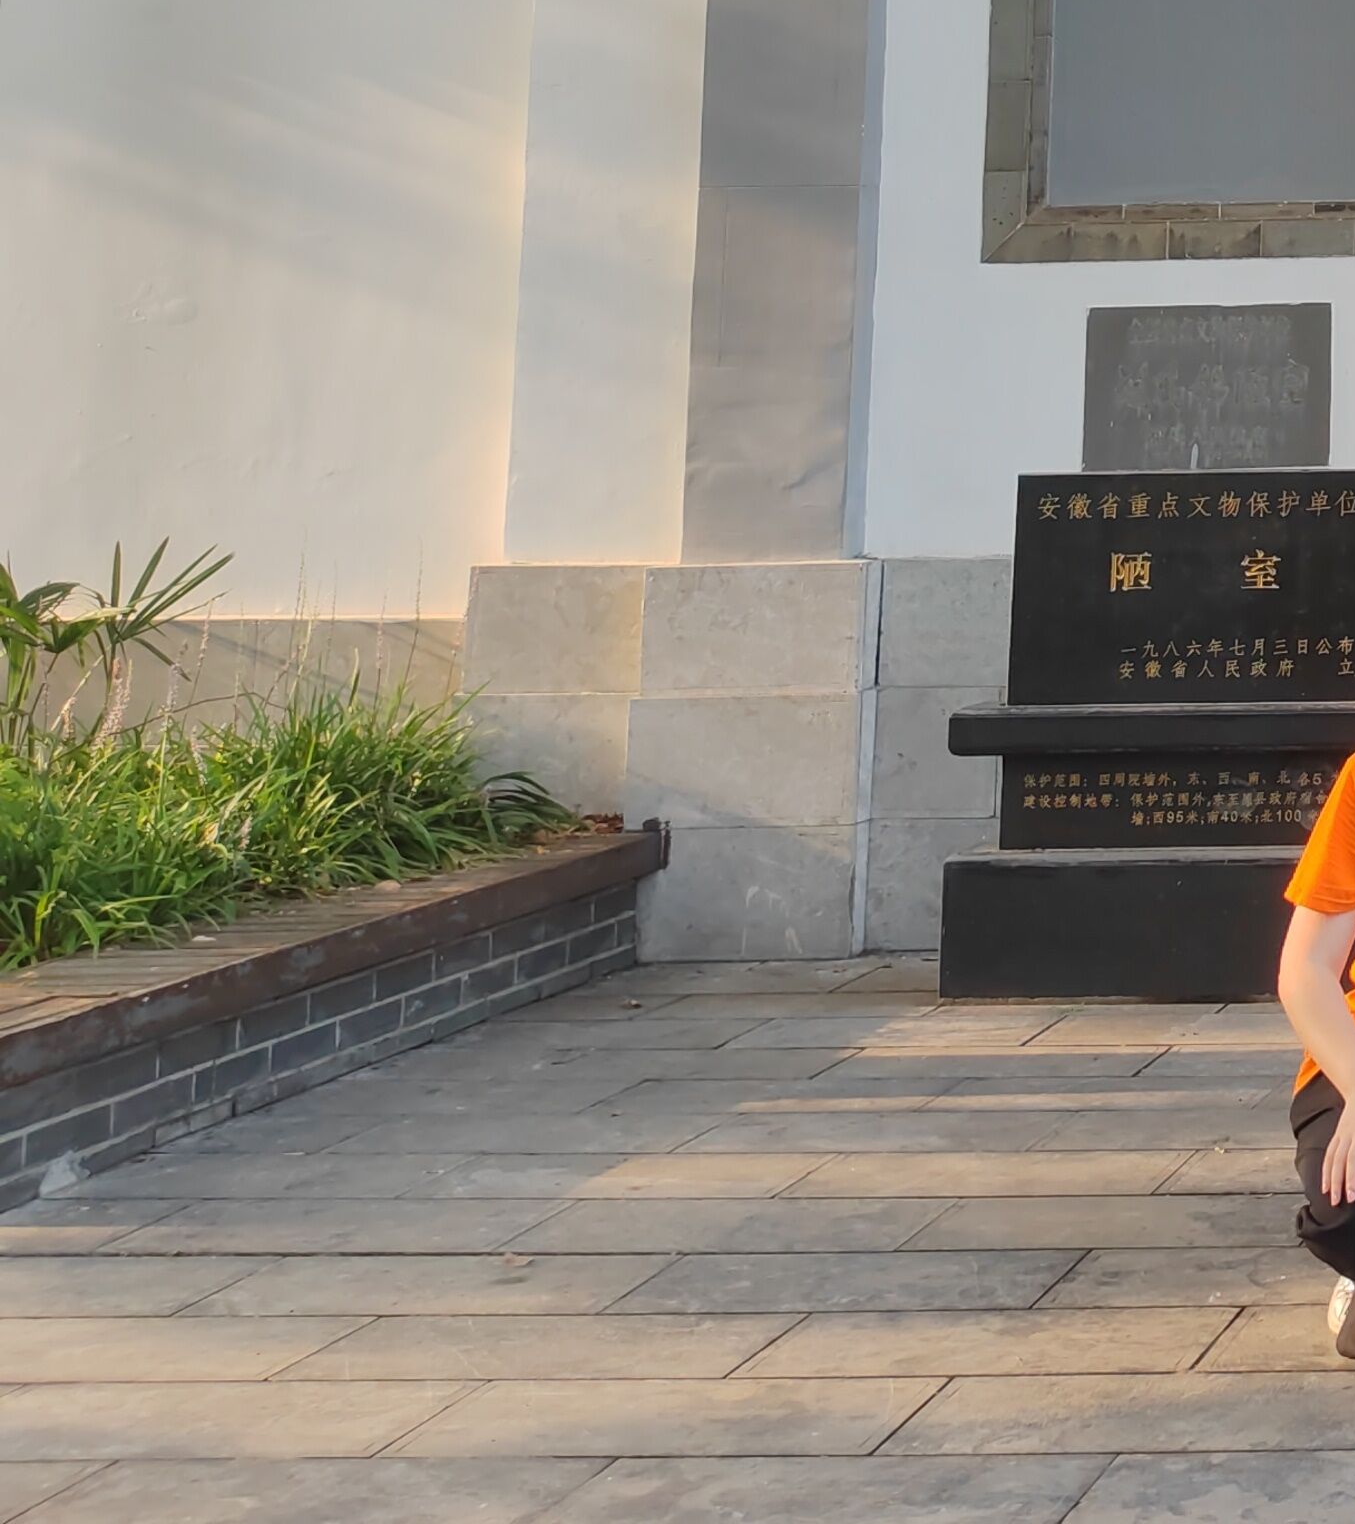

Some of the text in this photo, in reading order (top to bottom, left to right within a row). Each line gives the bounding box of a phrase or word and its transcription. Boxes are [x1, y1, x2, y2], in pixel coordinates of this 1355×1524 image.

[1120, 635, 1355, 659] 一九八六年七月三日公布
